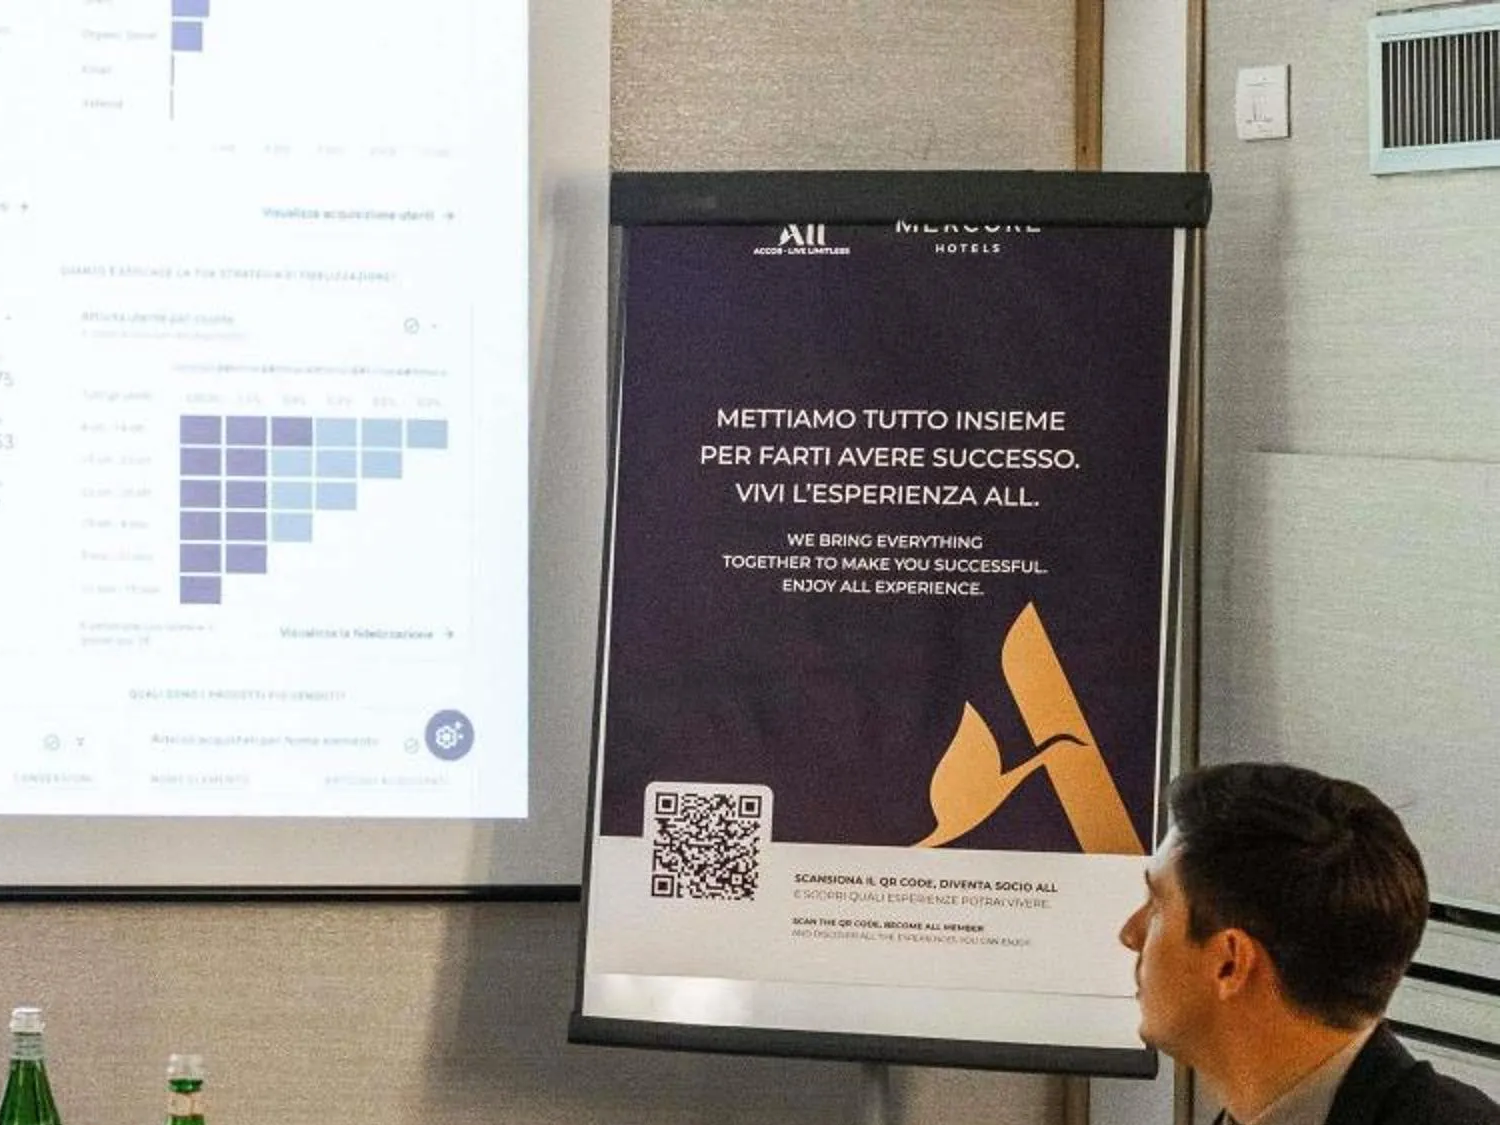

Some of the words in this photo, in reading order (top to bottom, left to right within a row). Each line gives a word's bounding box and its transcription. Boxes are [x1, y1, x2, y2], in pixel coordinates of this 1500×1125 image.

[935, 243, 1001, 254] HOTELS
[717, 408, 857, 430] METTIAMO
[863, 409, 949, 431] TUTTO
[956, 410, 1066, 432] INSIEME
[700, 445, 752, 466] PER
[759, 445, 831, 467] FARTI
[837, 446, 925, 468] AVERE
[932, 447, 1080, 469] SUCCESSO.
[735, 482, 785, 503] VIVI
[983, 485, 1040, 507] ALL.
[787, 533, 815, 547] WE
[819, 533, 873, 548] BRING
[876, 534, 983, 549] EVERYTHING
[722, 554, 811, 570] TOGETHER
[815, 556, 838, 571] TO
[841, 557, 891, 572] MAKE
[893, 557, 930, 572] YOU
[933, 558, 1048, 574] SUCCESSFUL.
[782, 578, 837, 593] ENJOY
[839, 579, 871, 594] ALL
[875, 580, 984, 596] EXPERIENCE.
[794, 873, 864, 886] SCANSIONA
[865, 876, 876, 887] IL
[879, 876, 897, 888] QR
[940, 879, 992, 890] DIVENTA
[995, 881, 1033, 892] SOCIO
[1035, 882, 1058, 893] ALL
[849, 891, 884, 903] QUALI
[792, 917, 817, 926] SCAN
[819, 918, 837, 927] THE
